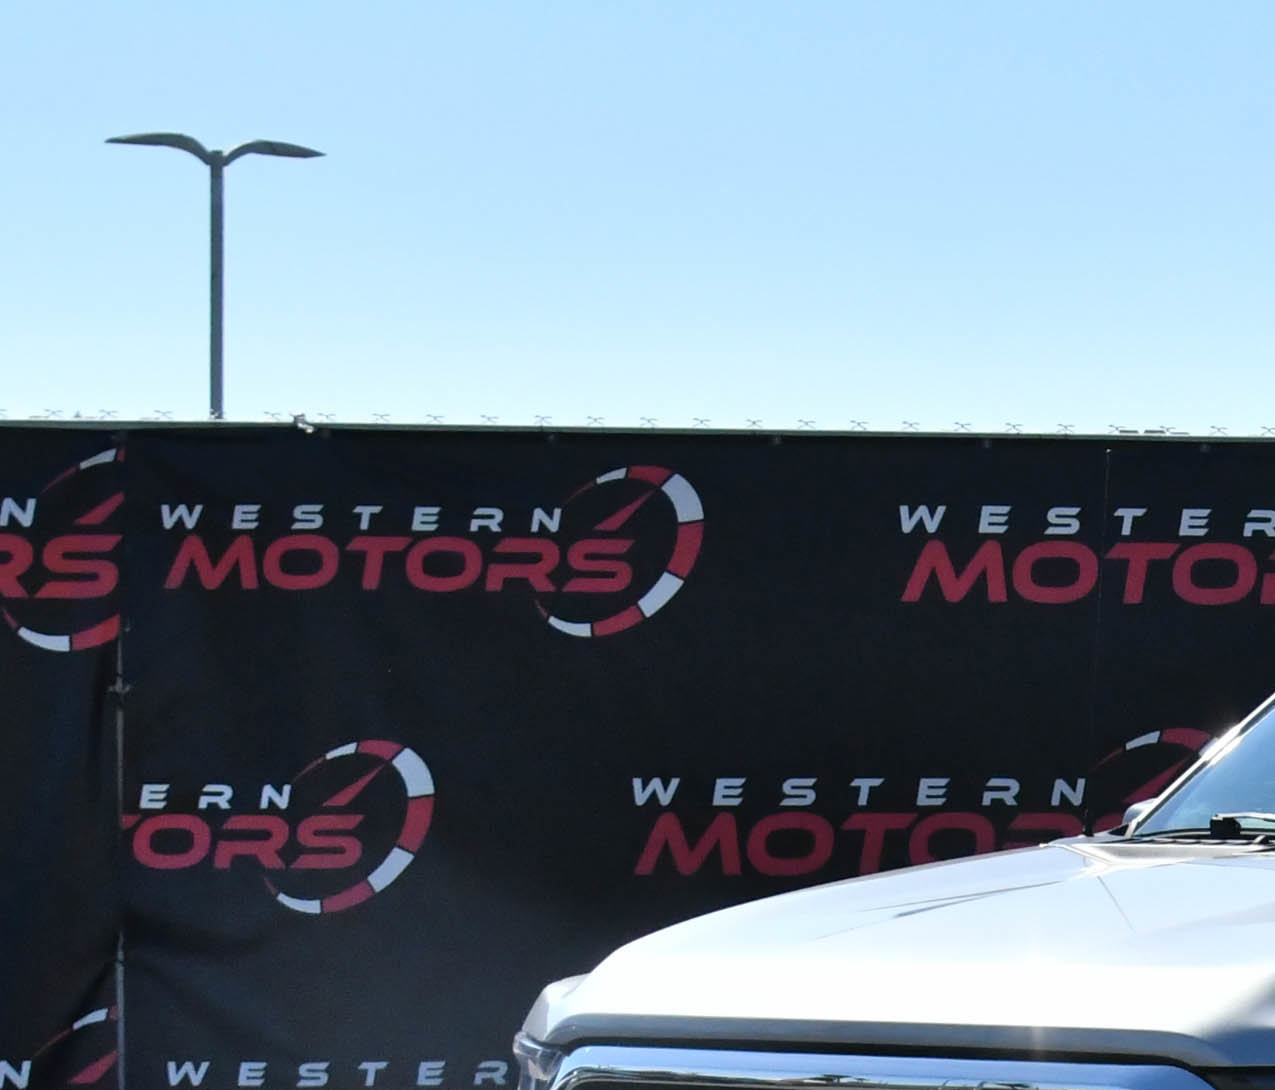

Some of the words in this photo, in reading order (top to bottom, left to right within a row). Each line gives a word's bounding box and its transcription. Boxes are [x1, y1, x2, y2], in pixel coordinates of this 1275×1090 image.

[160, 503, 565, 533] WESTERN
[163, 535, 636, 593] MOTORS
[632, 777, 1086, 806] WESTERN
[121, 813, 365, 870] ORS
[634, 812, 1126, 876] MOTO
